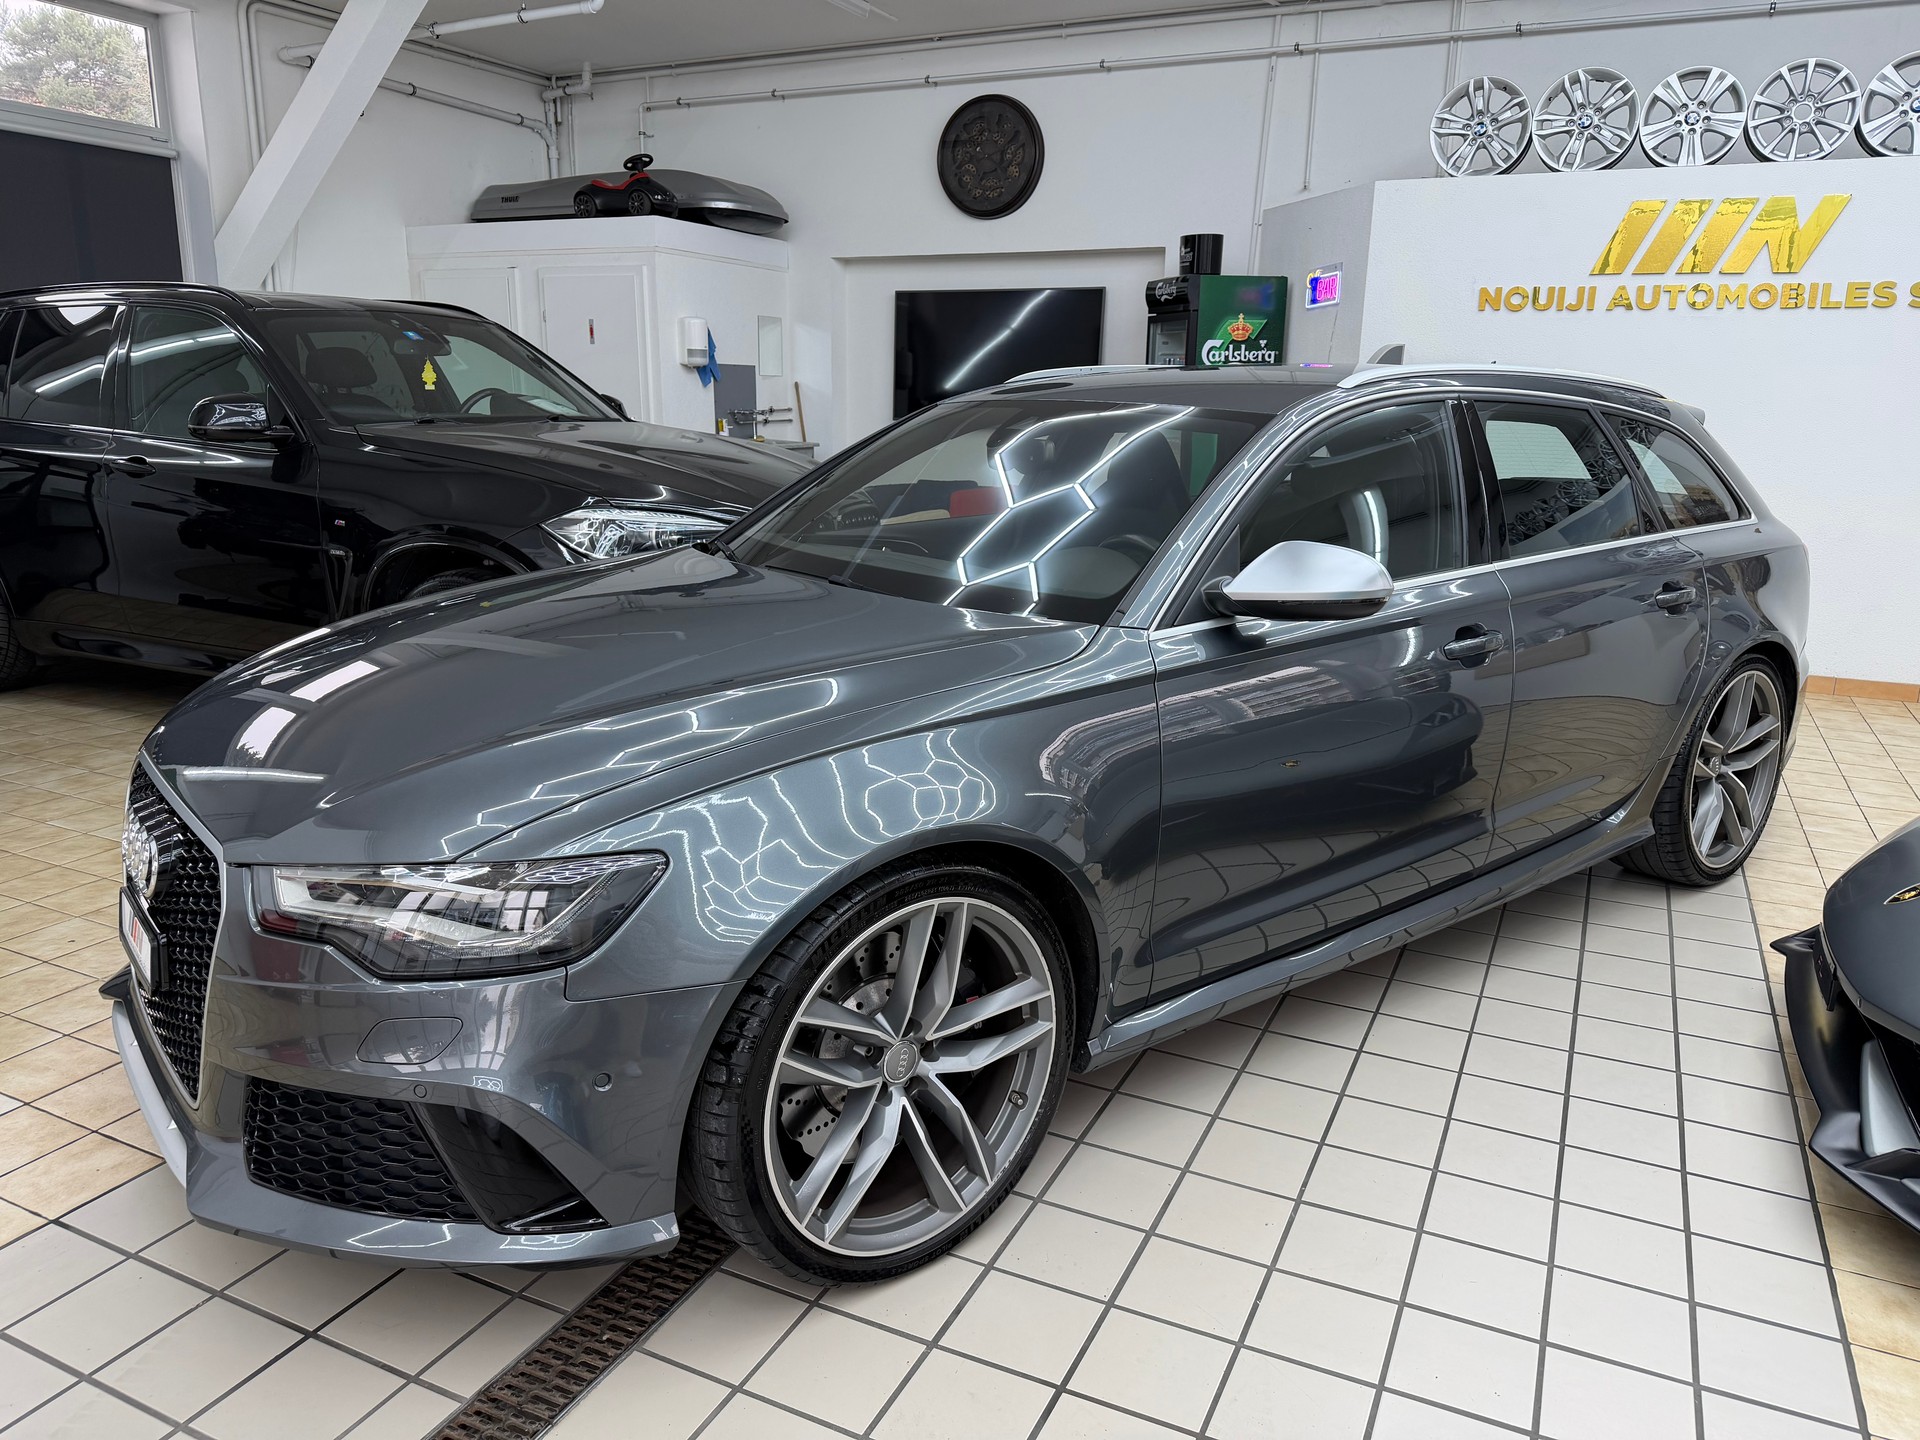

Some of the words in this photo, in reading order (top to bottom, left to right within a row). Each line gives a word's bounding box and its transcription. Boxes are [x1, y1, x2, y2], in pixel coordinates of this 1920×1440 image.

[501, 195, 519, 203] THULE
[1155, 280, 1177, 300] Carlsberg
[1317, 276, 1337, 301] BAR
[1478, 286, 1597, 312] NOUIJI
[1605, 281, 1898, 311] AUTOMOBILES
[1201, 339, 1276, 366] Carlsberg
[811, 894, 887, 967] MICHELIN
